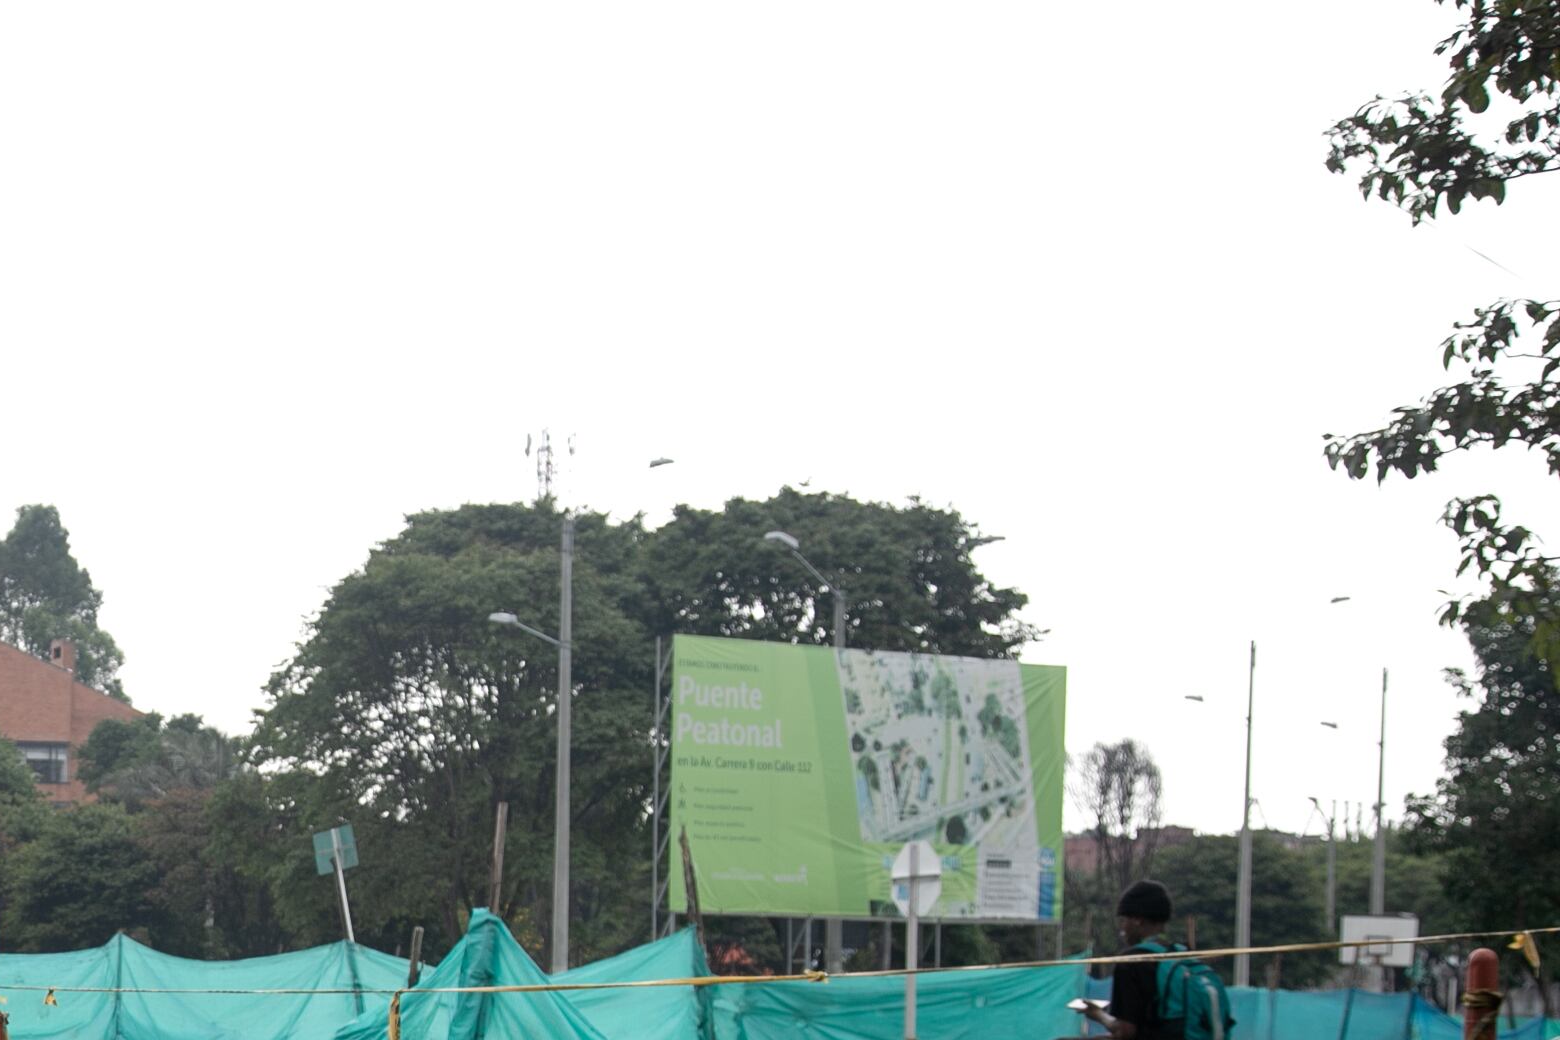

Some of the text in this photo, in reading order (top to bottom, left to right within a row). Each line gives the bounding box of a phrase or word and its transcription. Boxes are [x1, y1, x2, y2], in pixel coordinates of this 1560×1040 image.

[679, 675, 762, 710] Puente
[676, 712, 783, 748] Peatonal
[678, 757, 688, 767] en
[715, 756, 748, 770] Carrera
[757, 760, 773, 771] con
[775, 760, 795, 773] Calle
